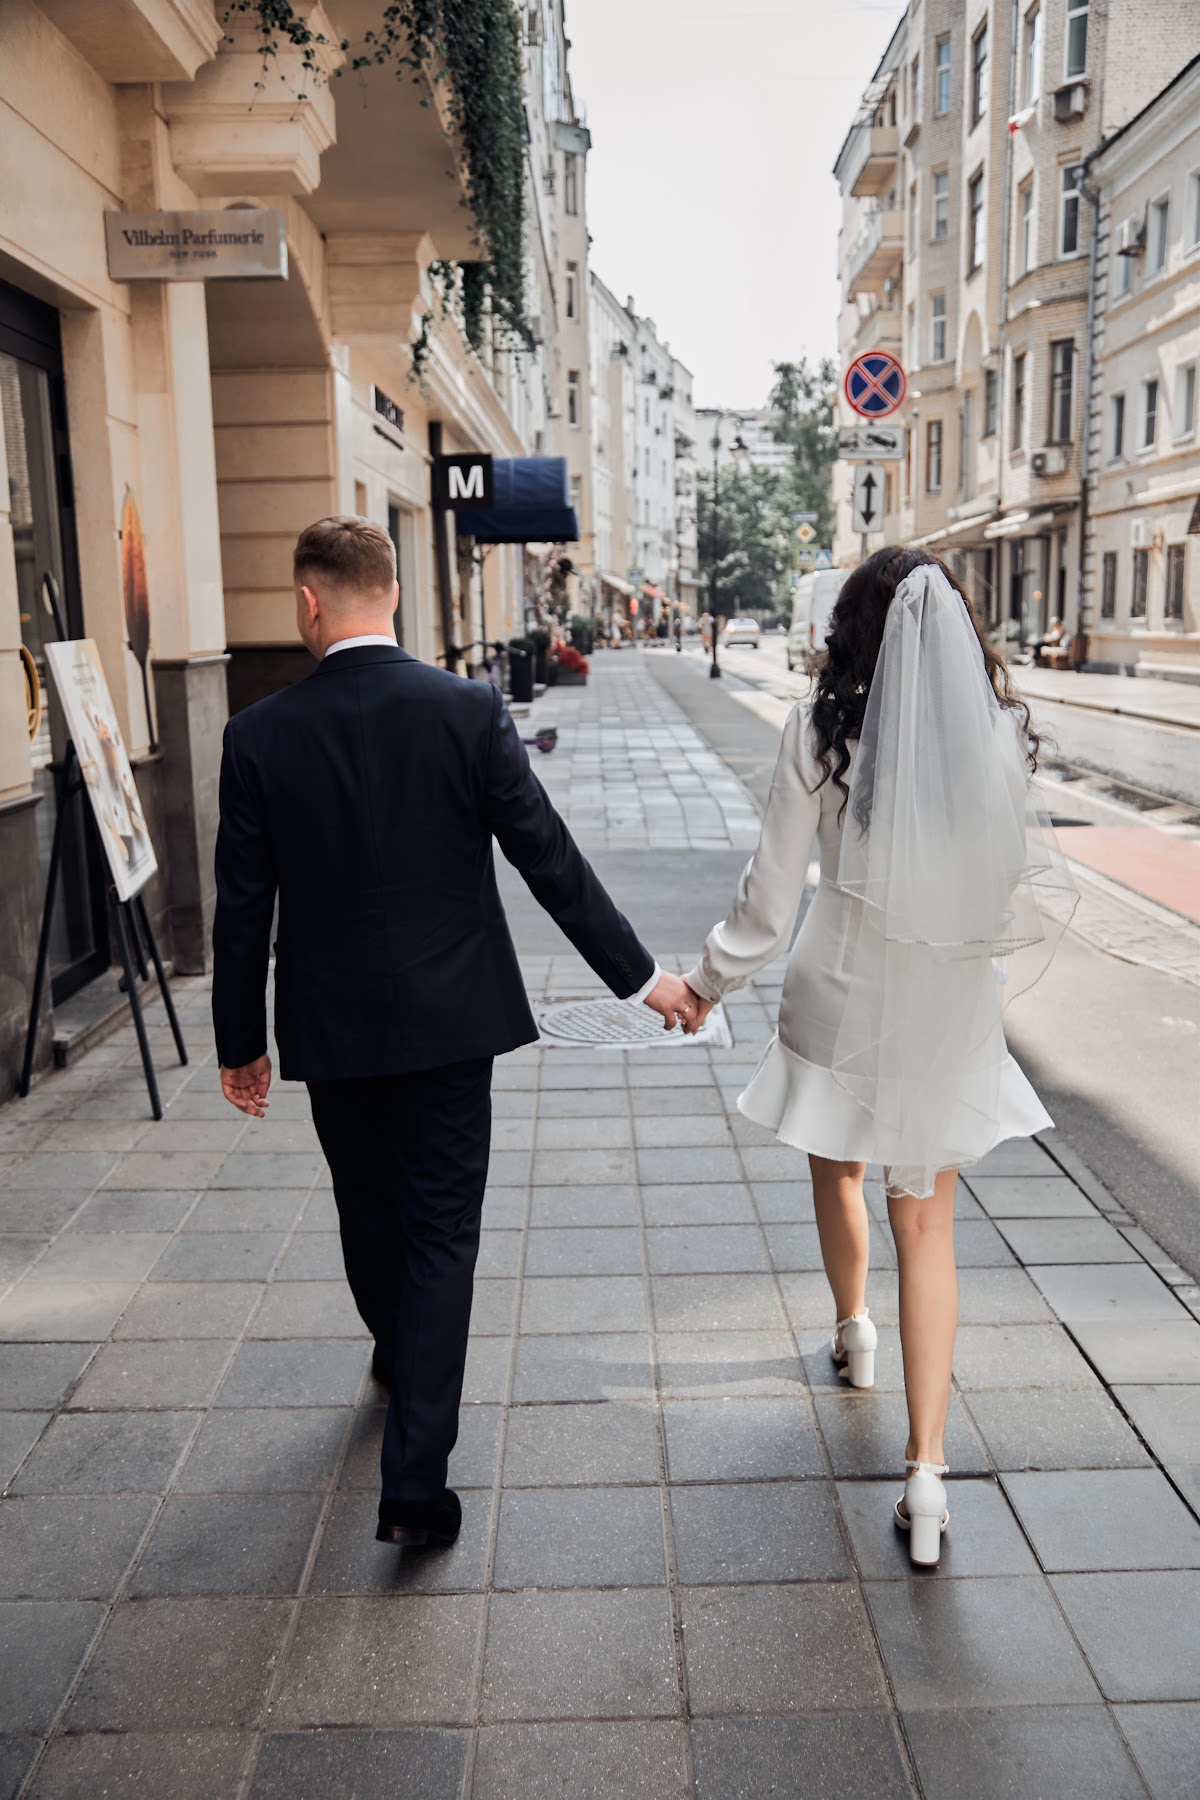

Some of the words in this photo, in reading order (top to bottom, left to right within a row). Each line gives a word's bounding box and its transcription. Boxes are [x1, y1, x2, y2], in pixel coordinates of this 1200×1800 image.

[122, 229, 180, 246] Vilhelm
[183, 228, 264, 245] Parfumerie
[448, 464, 485, 499] M
